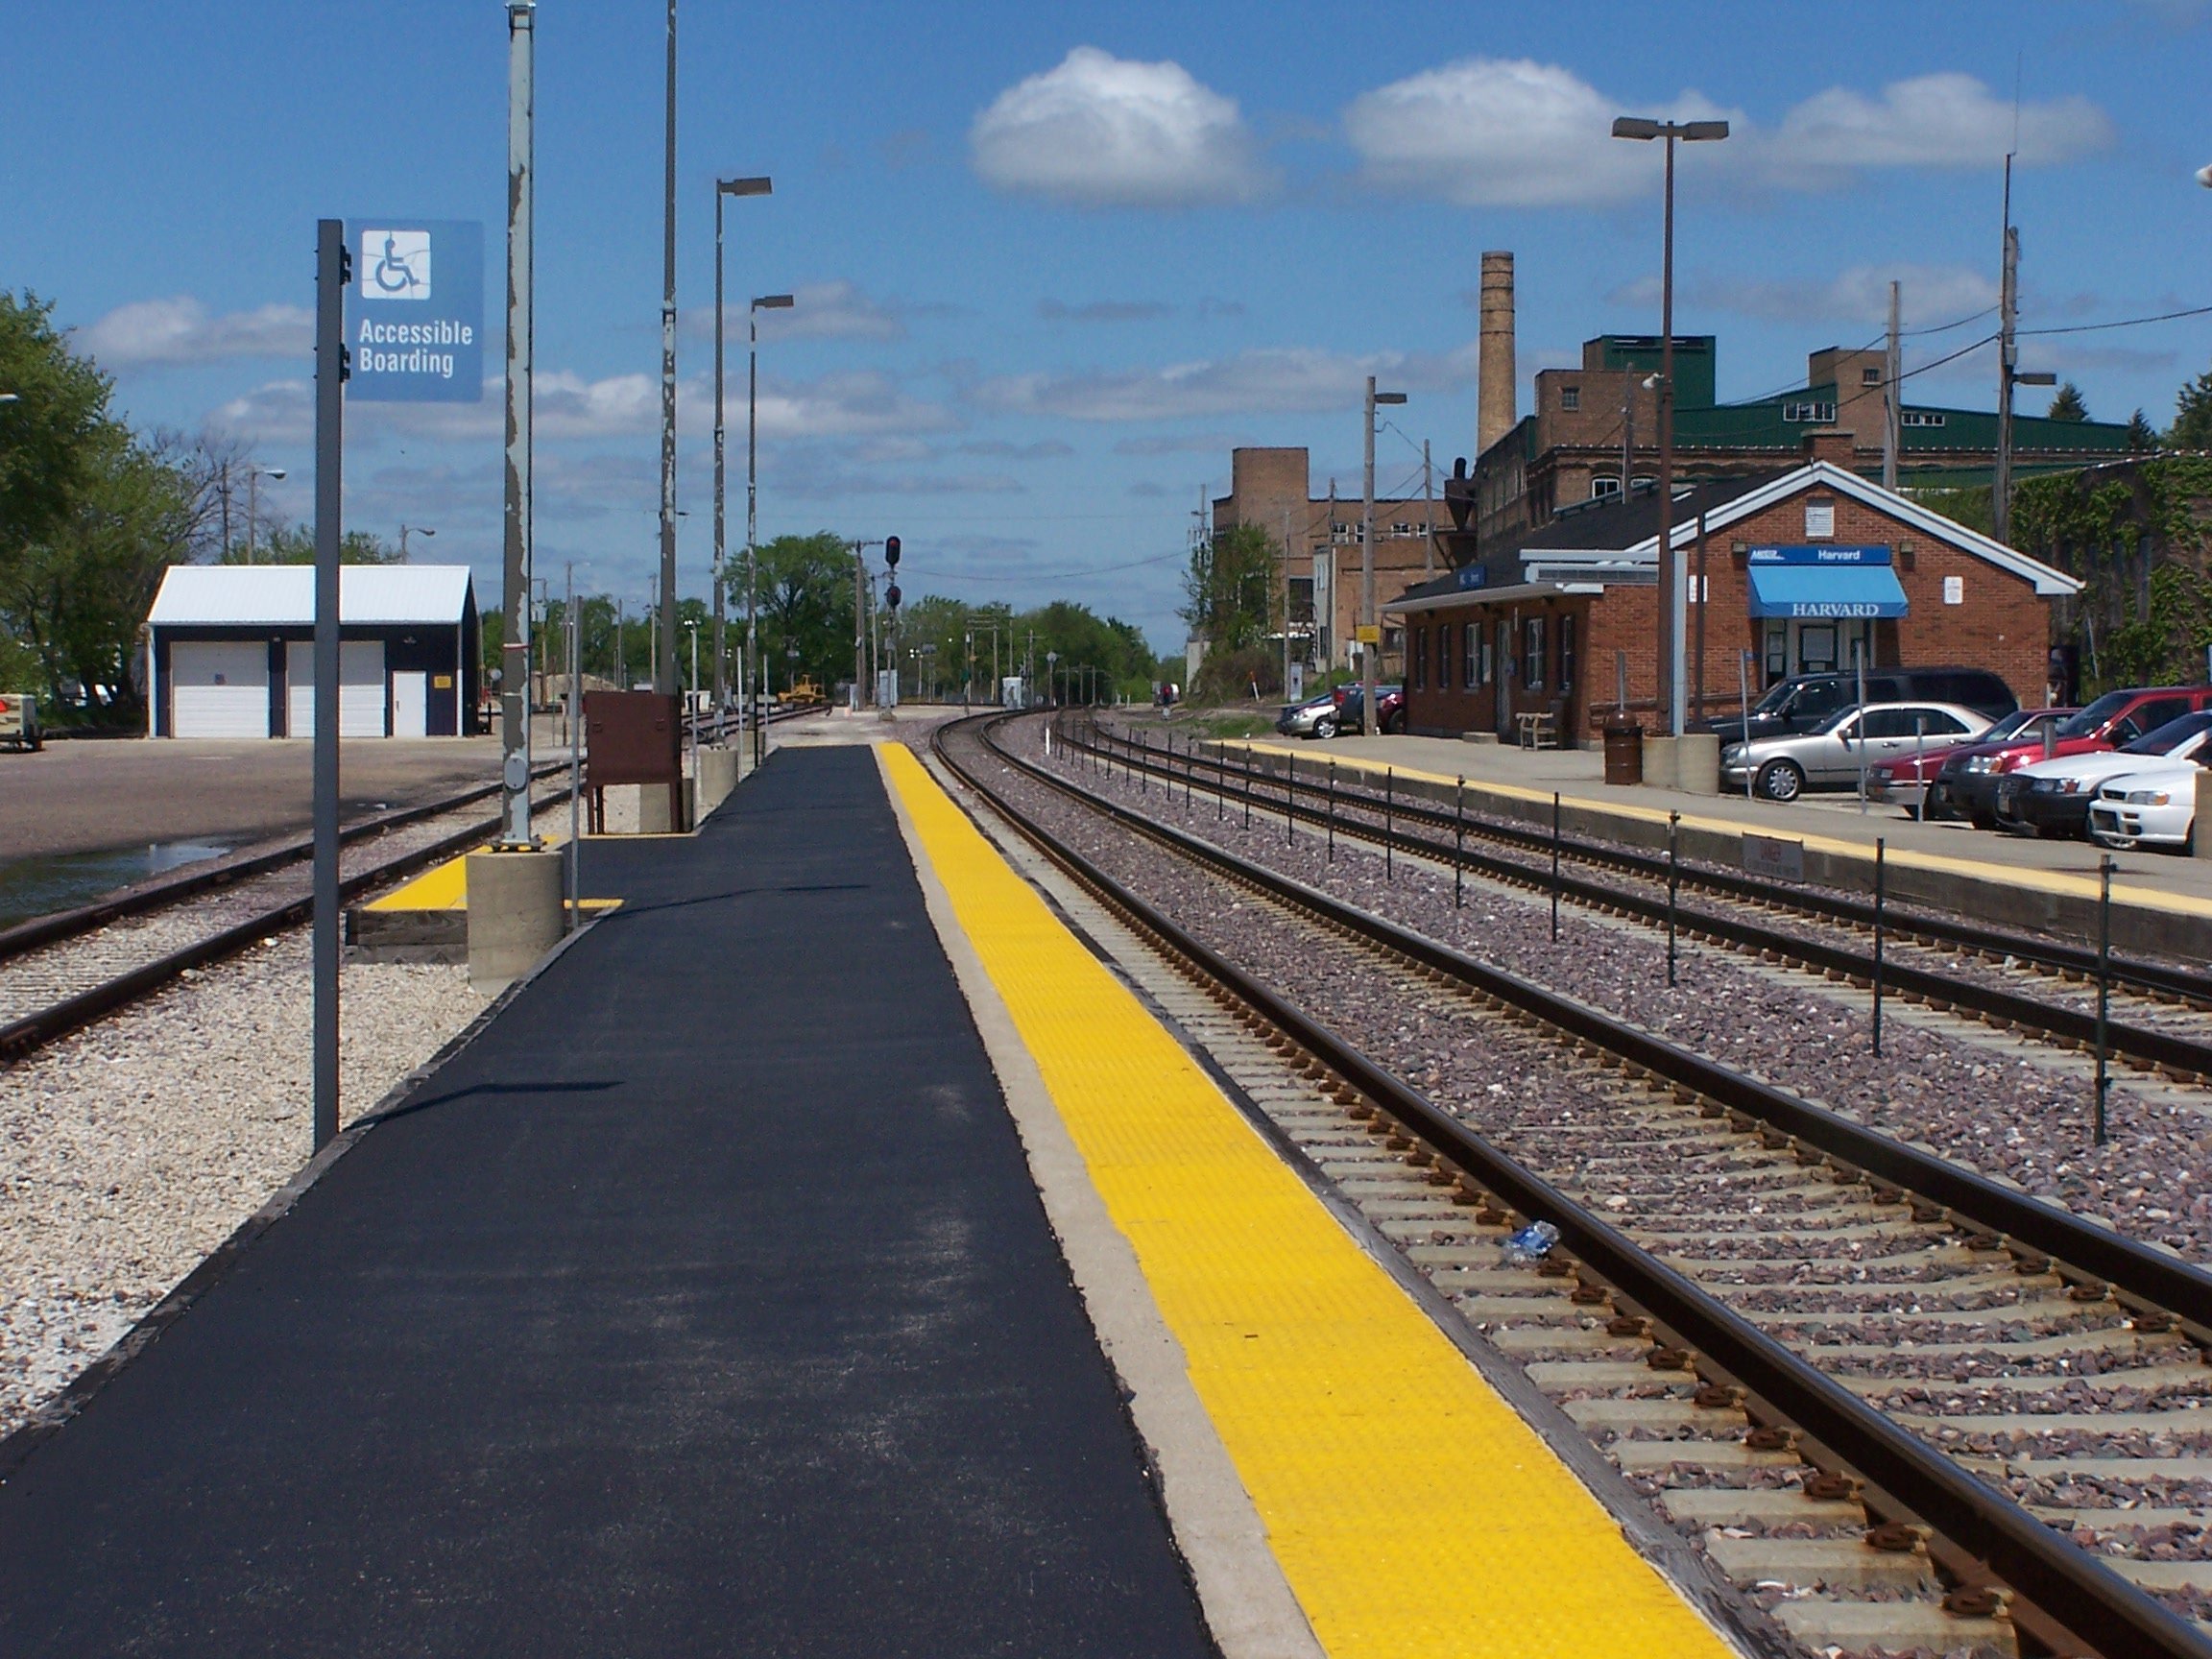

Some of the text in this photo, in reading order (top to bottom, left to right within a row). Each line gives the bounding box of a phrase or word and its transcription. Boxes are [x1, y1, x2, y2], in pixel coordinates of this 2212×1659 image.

[358, 319, 473, 345] Accessible
[358, 348, 455, 379] Boarding
[1817, 549, 1862, 561] Harvard
[1792, 603, 1880, 616] HARVARD
